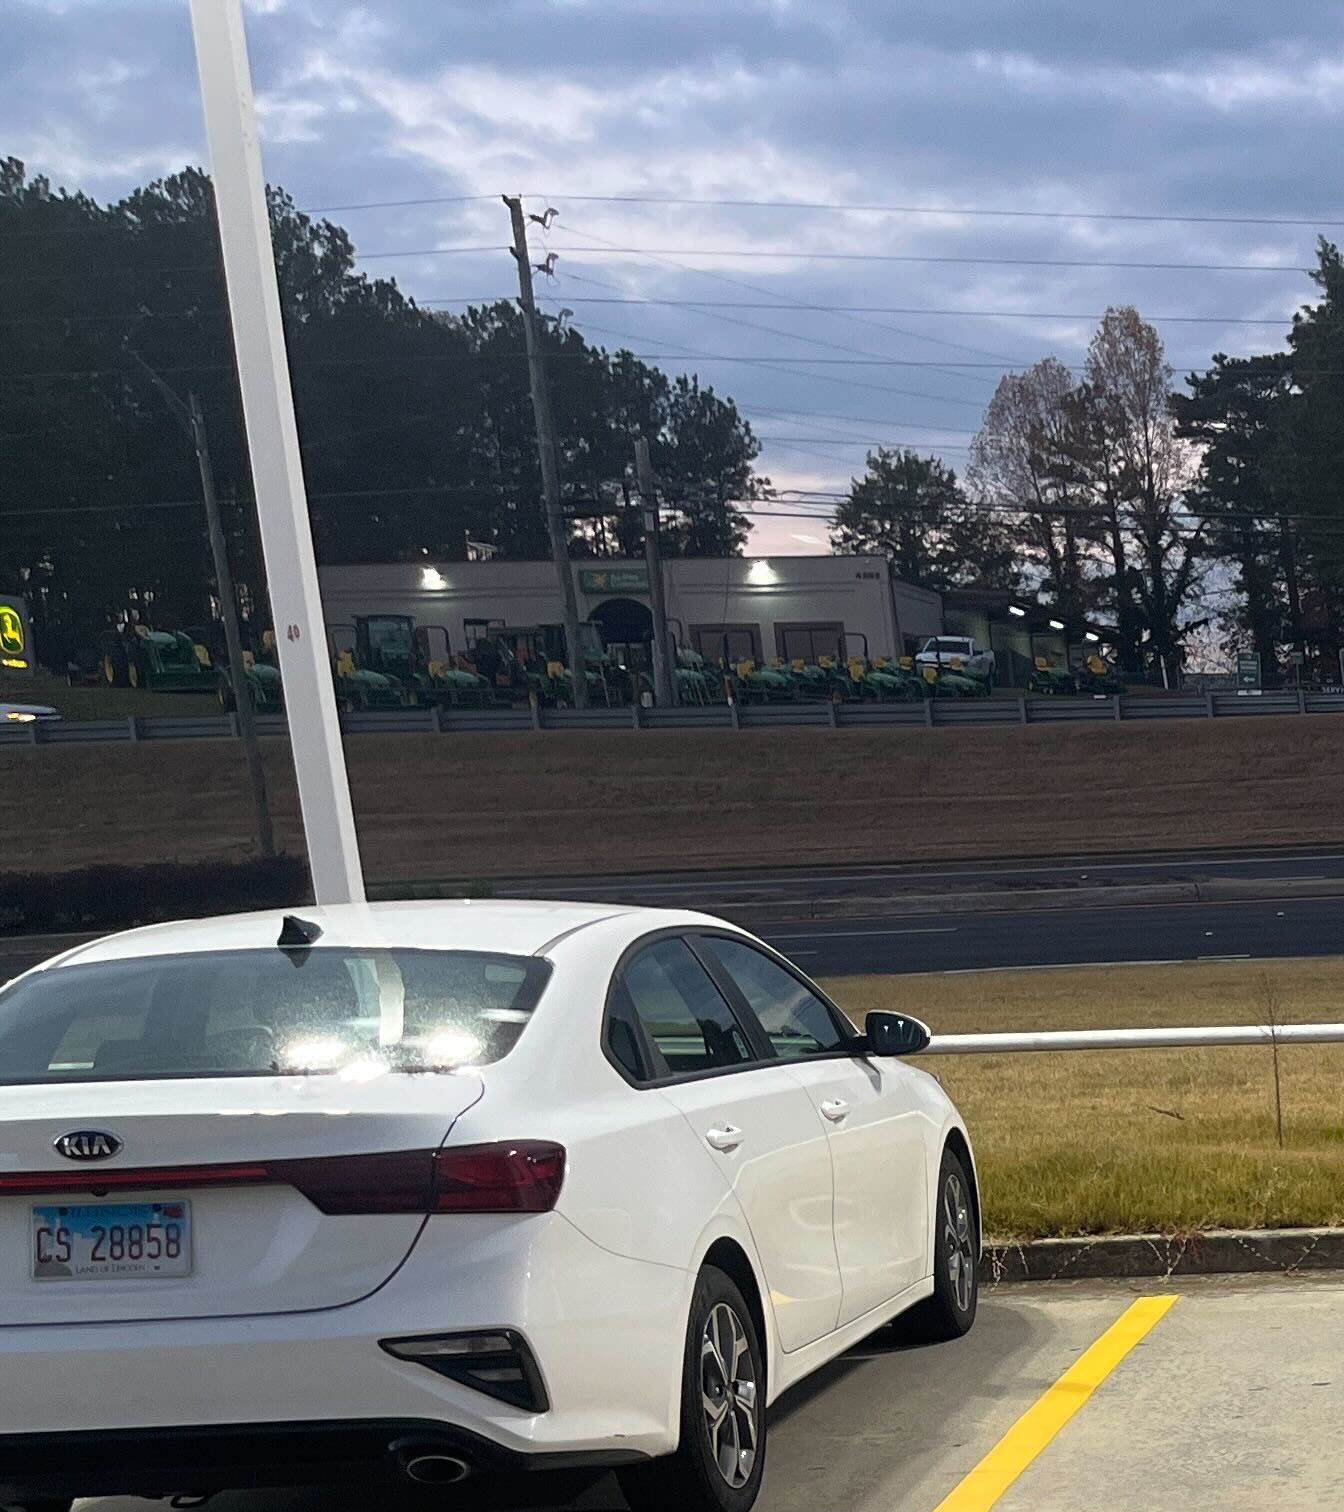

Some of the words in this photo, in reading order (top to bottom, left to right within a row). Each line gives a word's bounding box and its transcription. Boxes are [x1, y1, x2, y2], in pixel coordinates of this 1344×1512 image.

[287, 624, 300, 641] 40
[63, 1135, 112, 1156] KIA
[36, 1226, 72, 1264] CS
[91, 1223, 181, 1262] 28858
